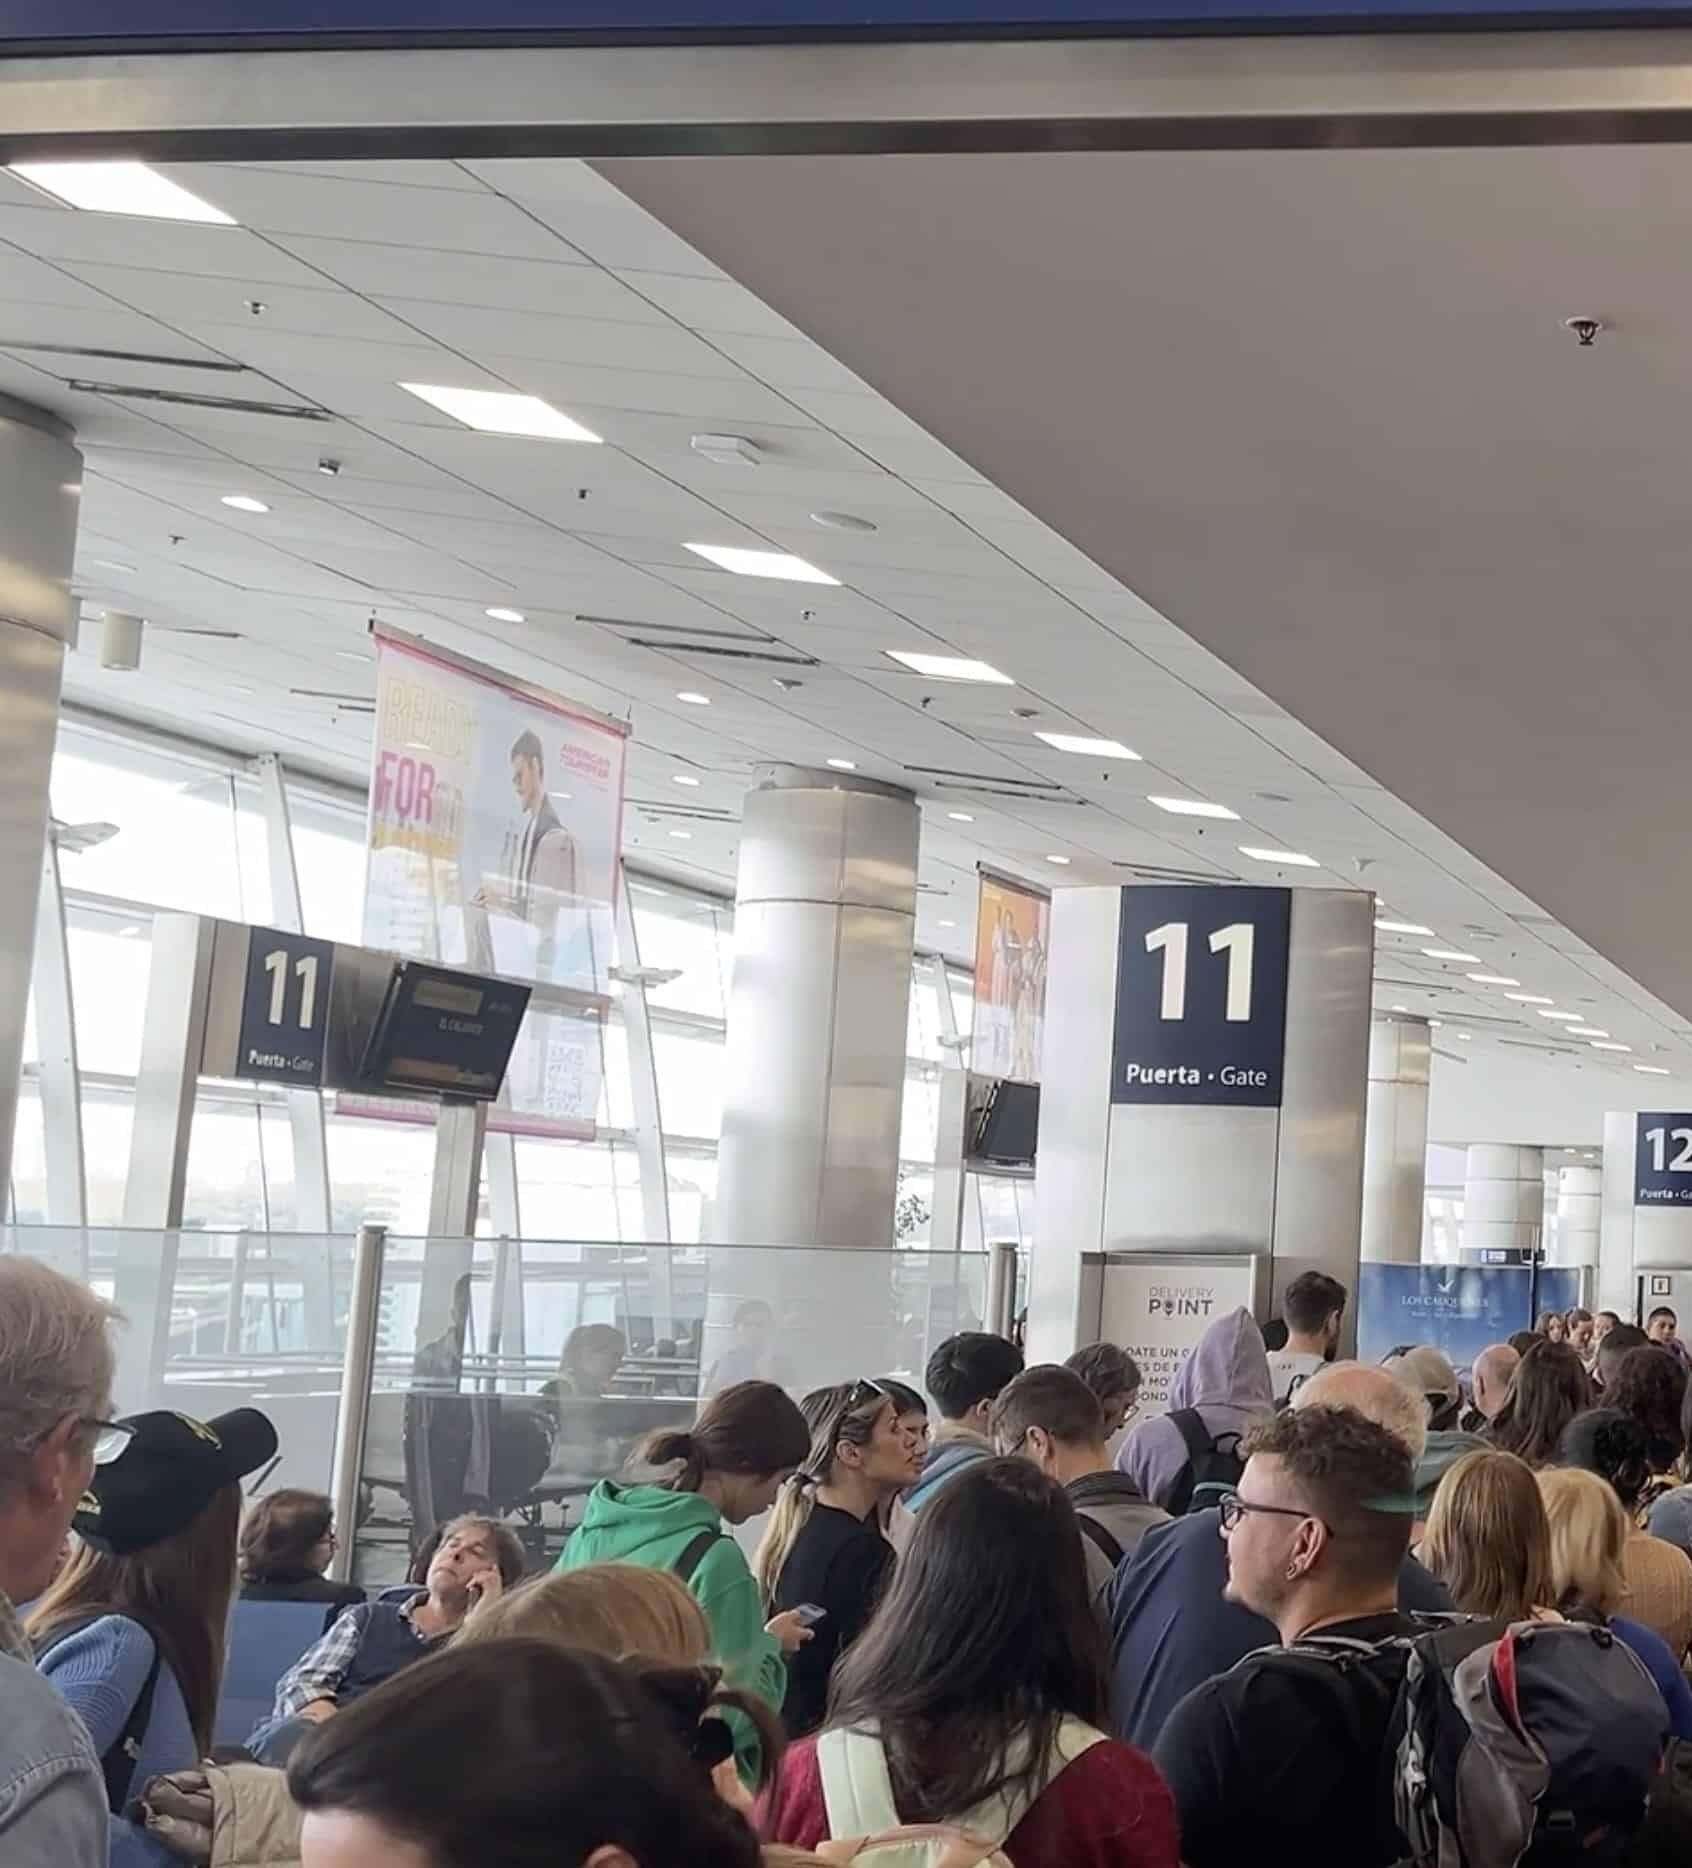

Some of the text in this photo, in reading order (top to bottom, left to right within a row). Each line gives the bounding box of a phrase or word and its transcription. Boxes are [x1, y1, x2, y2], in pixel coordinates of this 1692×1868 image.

[375, 750, 435, 825] FOR
[1145, 922, 1255, 1022] 11
[265, 950, 318, 1030] 11
[248, 1049, 286, 1069] Puerta
[1126, 1064, 1268, 1086] Puerta Gate
[1149, 1287, 1215, 1298] DELIVERY
[1160, 1347, 1178, 1358] UN
[1153, 1361, 1169, 1373] DE
